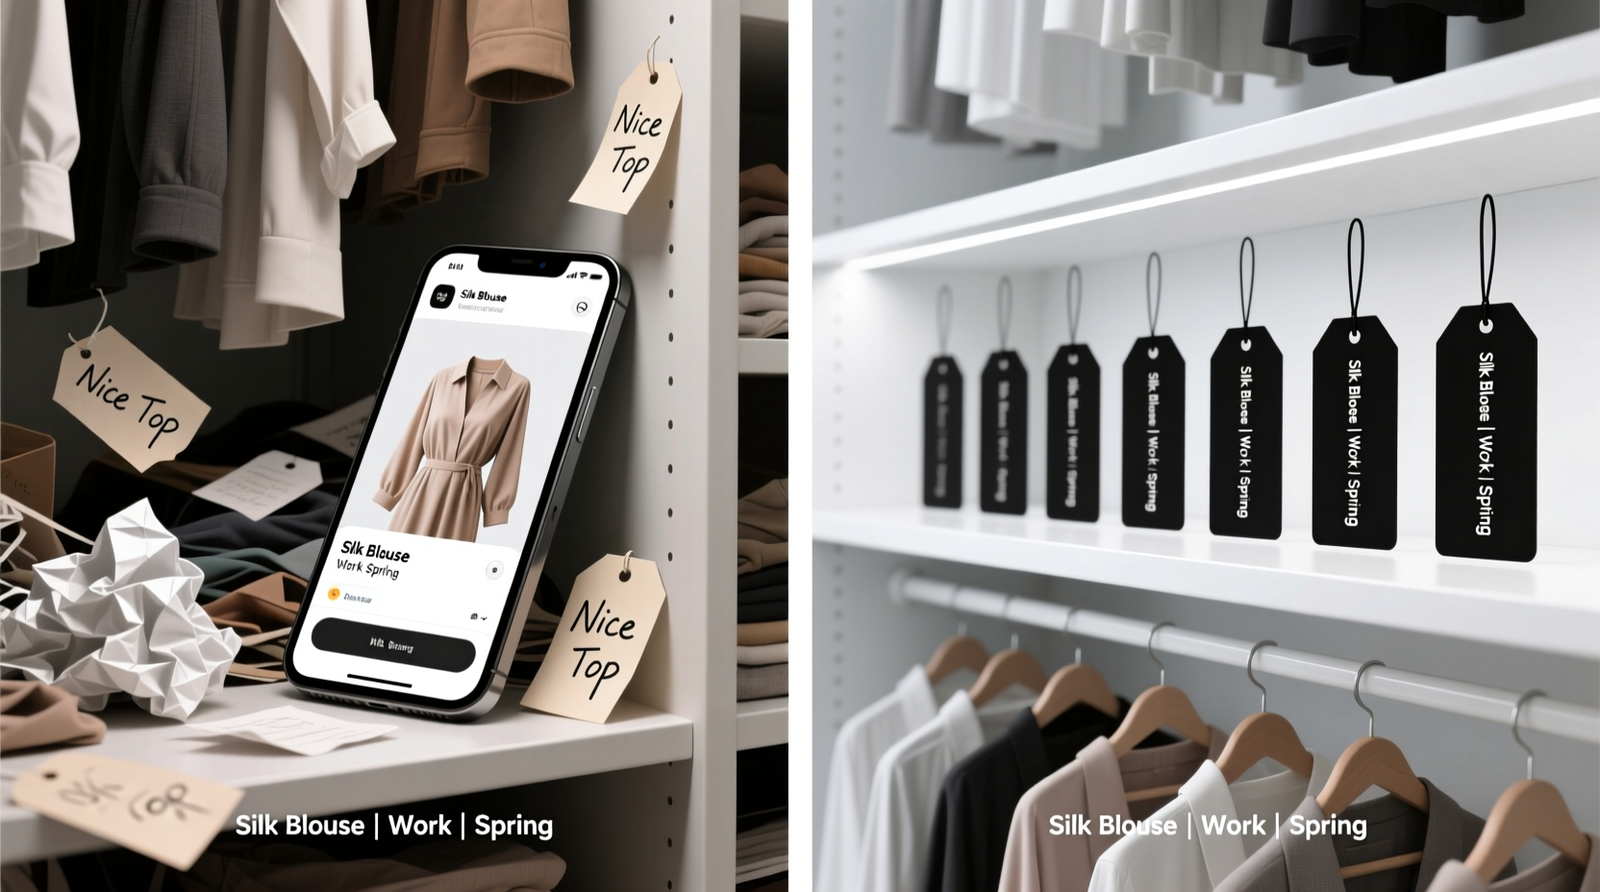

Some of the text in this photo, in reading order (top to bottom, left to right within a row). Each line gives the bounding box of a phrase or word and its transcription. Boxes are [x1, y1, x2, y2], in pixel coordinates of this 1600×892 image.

[613, 104, 662, 137] Nice
[612, 145, 650, 193] Top
[76, 363, 179, 449] Nice Top
[570, 599, 635, 640] Nice
[572, 647, 620, 700] Top
